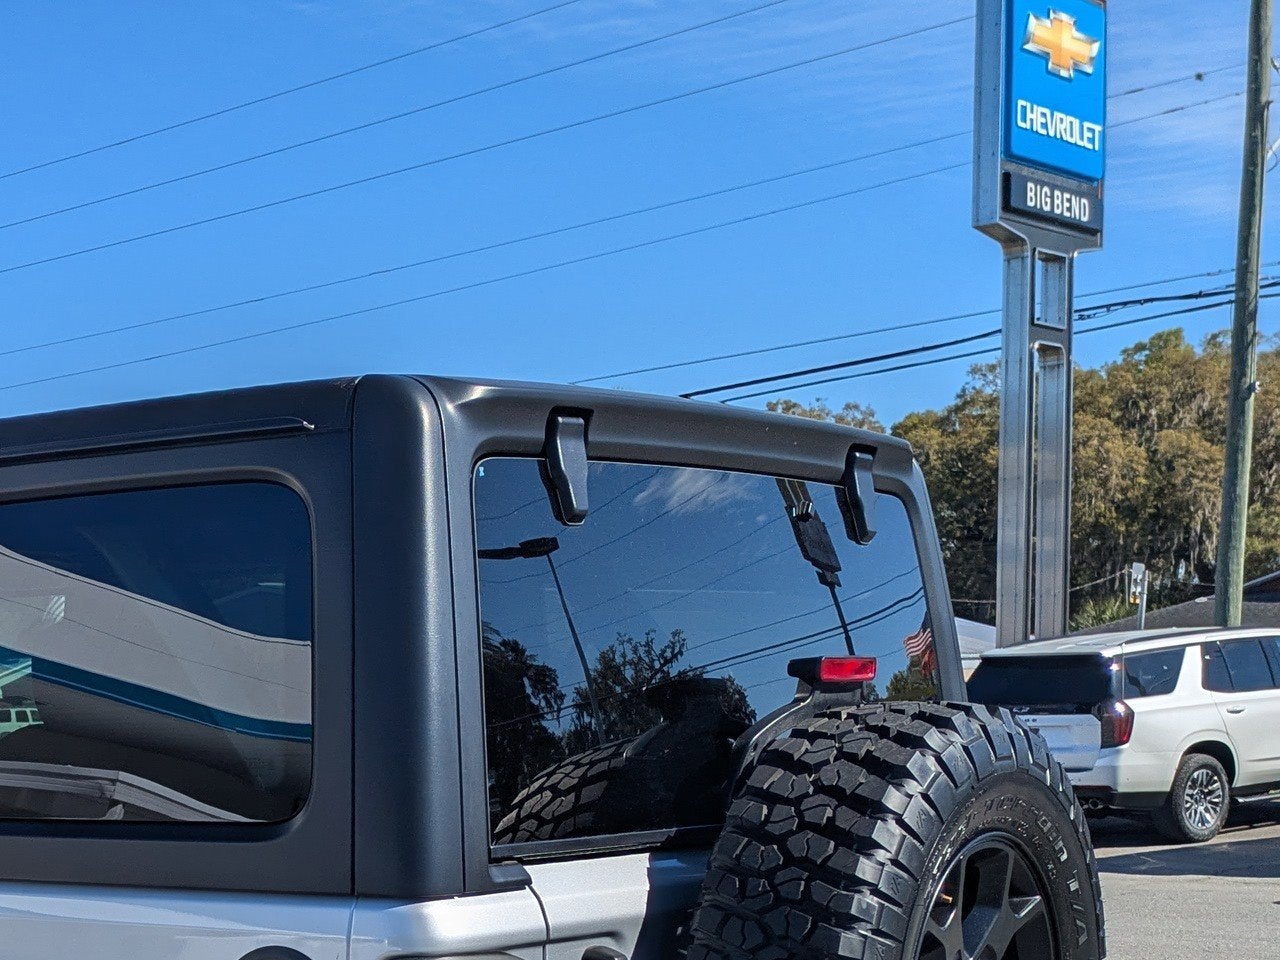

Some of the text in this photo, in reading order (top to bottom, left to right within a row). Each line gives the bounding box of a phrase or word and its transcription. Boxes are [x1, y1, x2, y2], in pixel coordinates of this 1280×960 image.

[1017, 99, 1103, 151] CHEVROLET
[1026, 182, 1090, 222] BIG BEND
